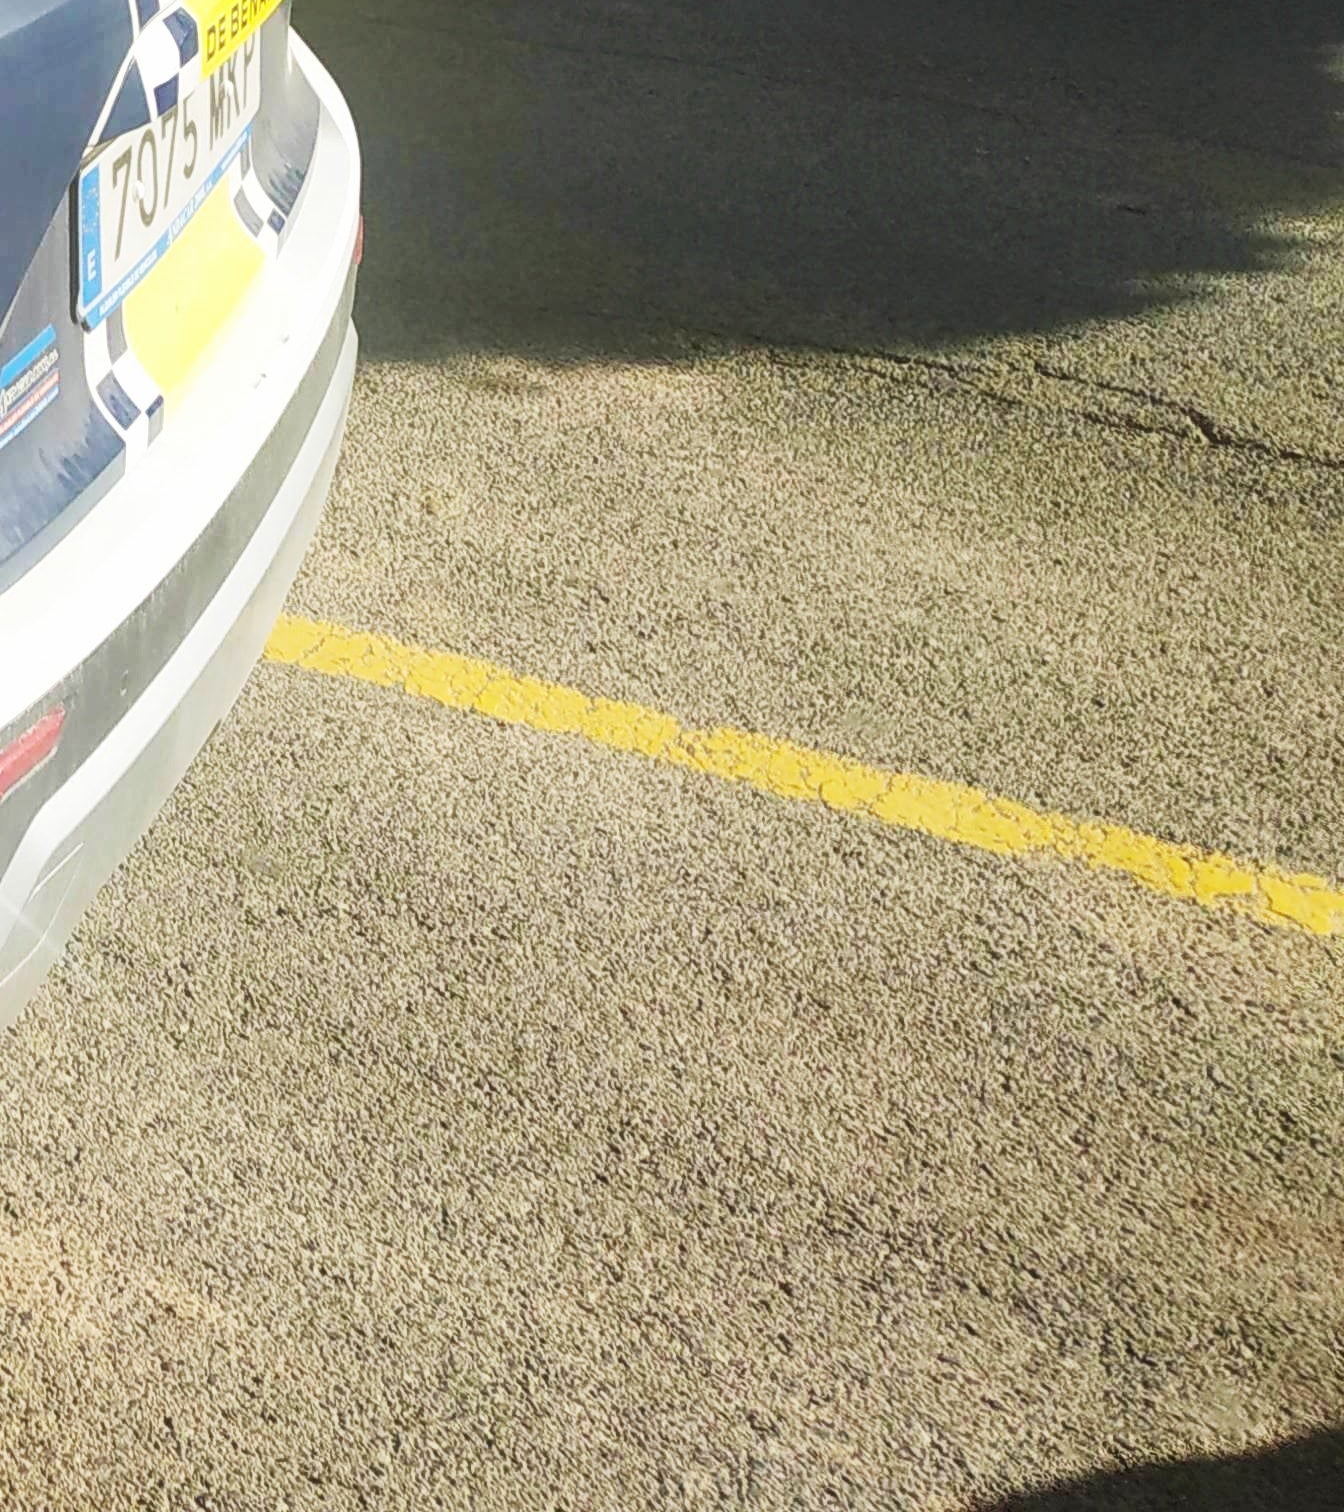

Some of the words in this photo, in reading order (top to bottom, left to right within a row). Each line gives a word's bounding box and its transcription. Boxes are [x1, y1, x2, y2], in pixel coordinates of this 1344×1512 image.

[205, 16, 228, 63] DE
[112, 88, 198, 263] 7075
[87, 247, 97, 283] E
